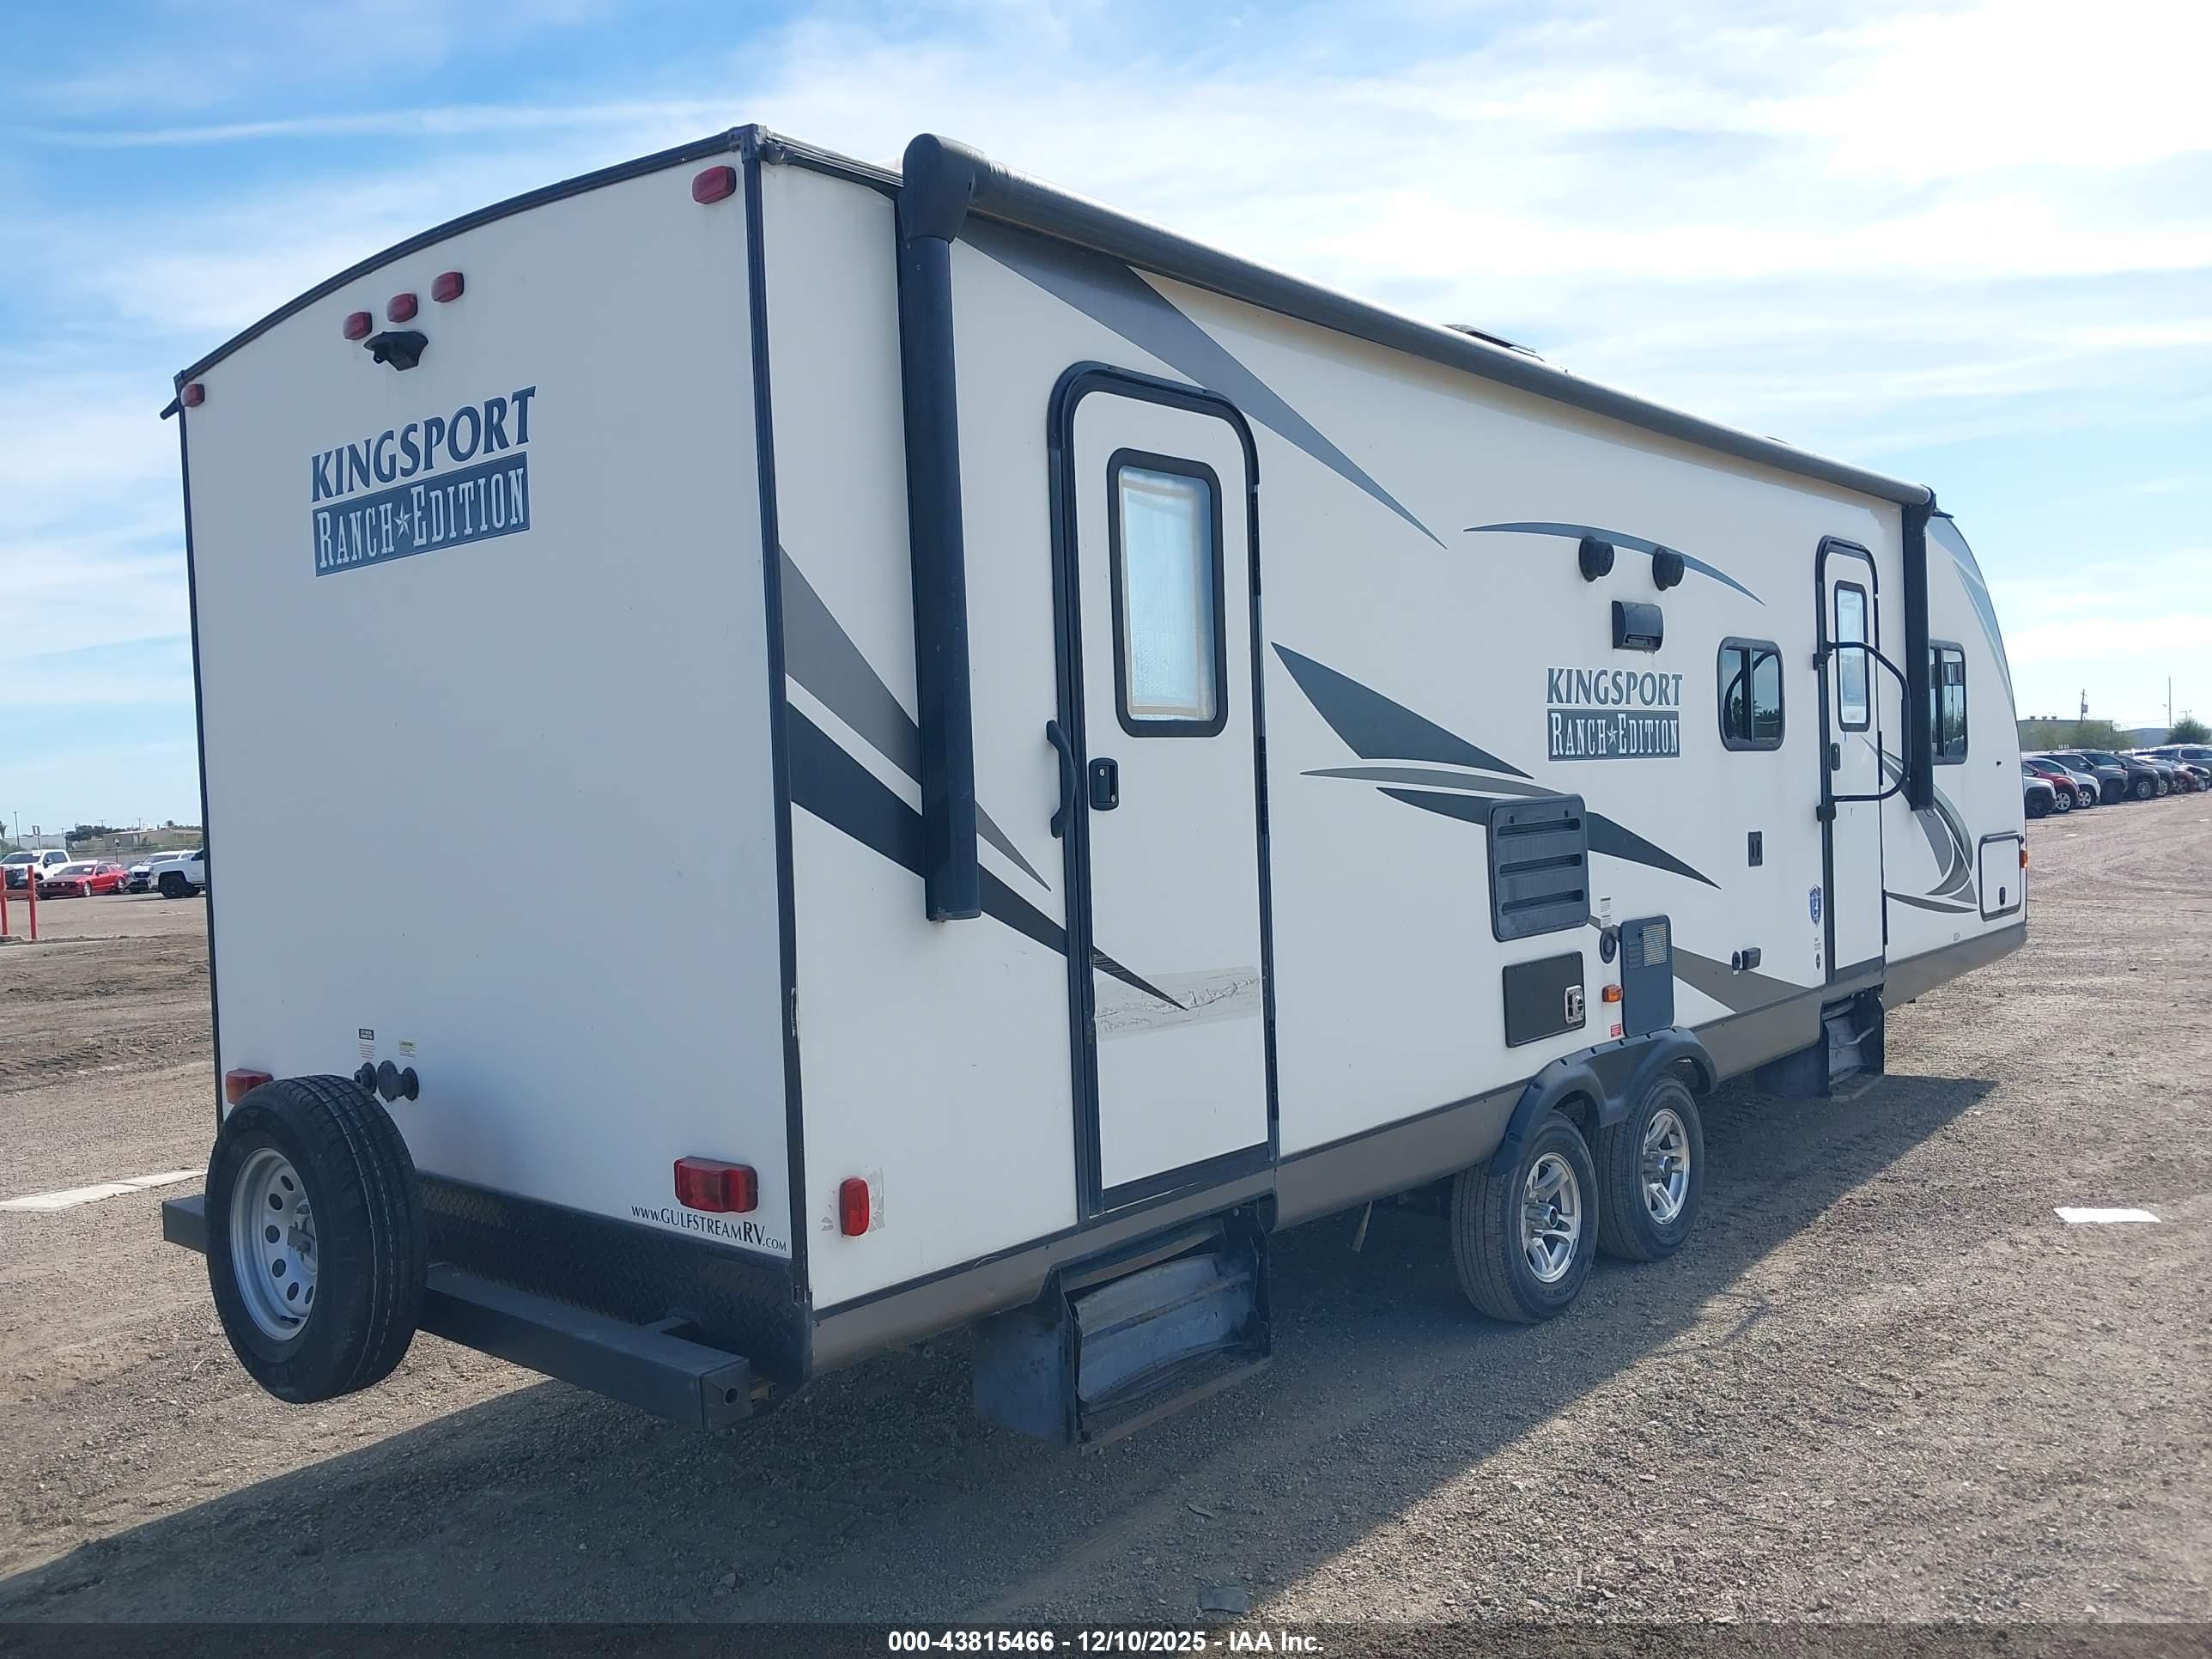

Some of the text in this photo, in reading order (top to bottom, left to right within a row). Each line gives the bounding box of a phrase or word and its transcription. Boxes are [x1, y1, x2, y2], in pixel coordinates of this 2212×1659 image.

[311, 386, 536, 502] KINGSPORT
[317, 467, 525, 568] RANCH EDITION
[1547, 667, 1683, 706] KINGSPORT
[1551, 712, 1678, 757] RANCH EDITION
